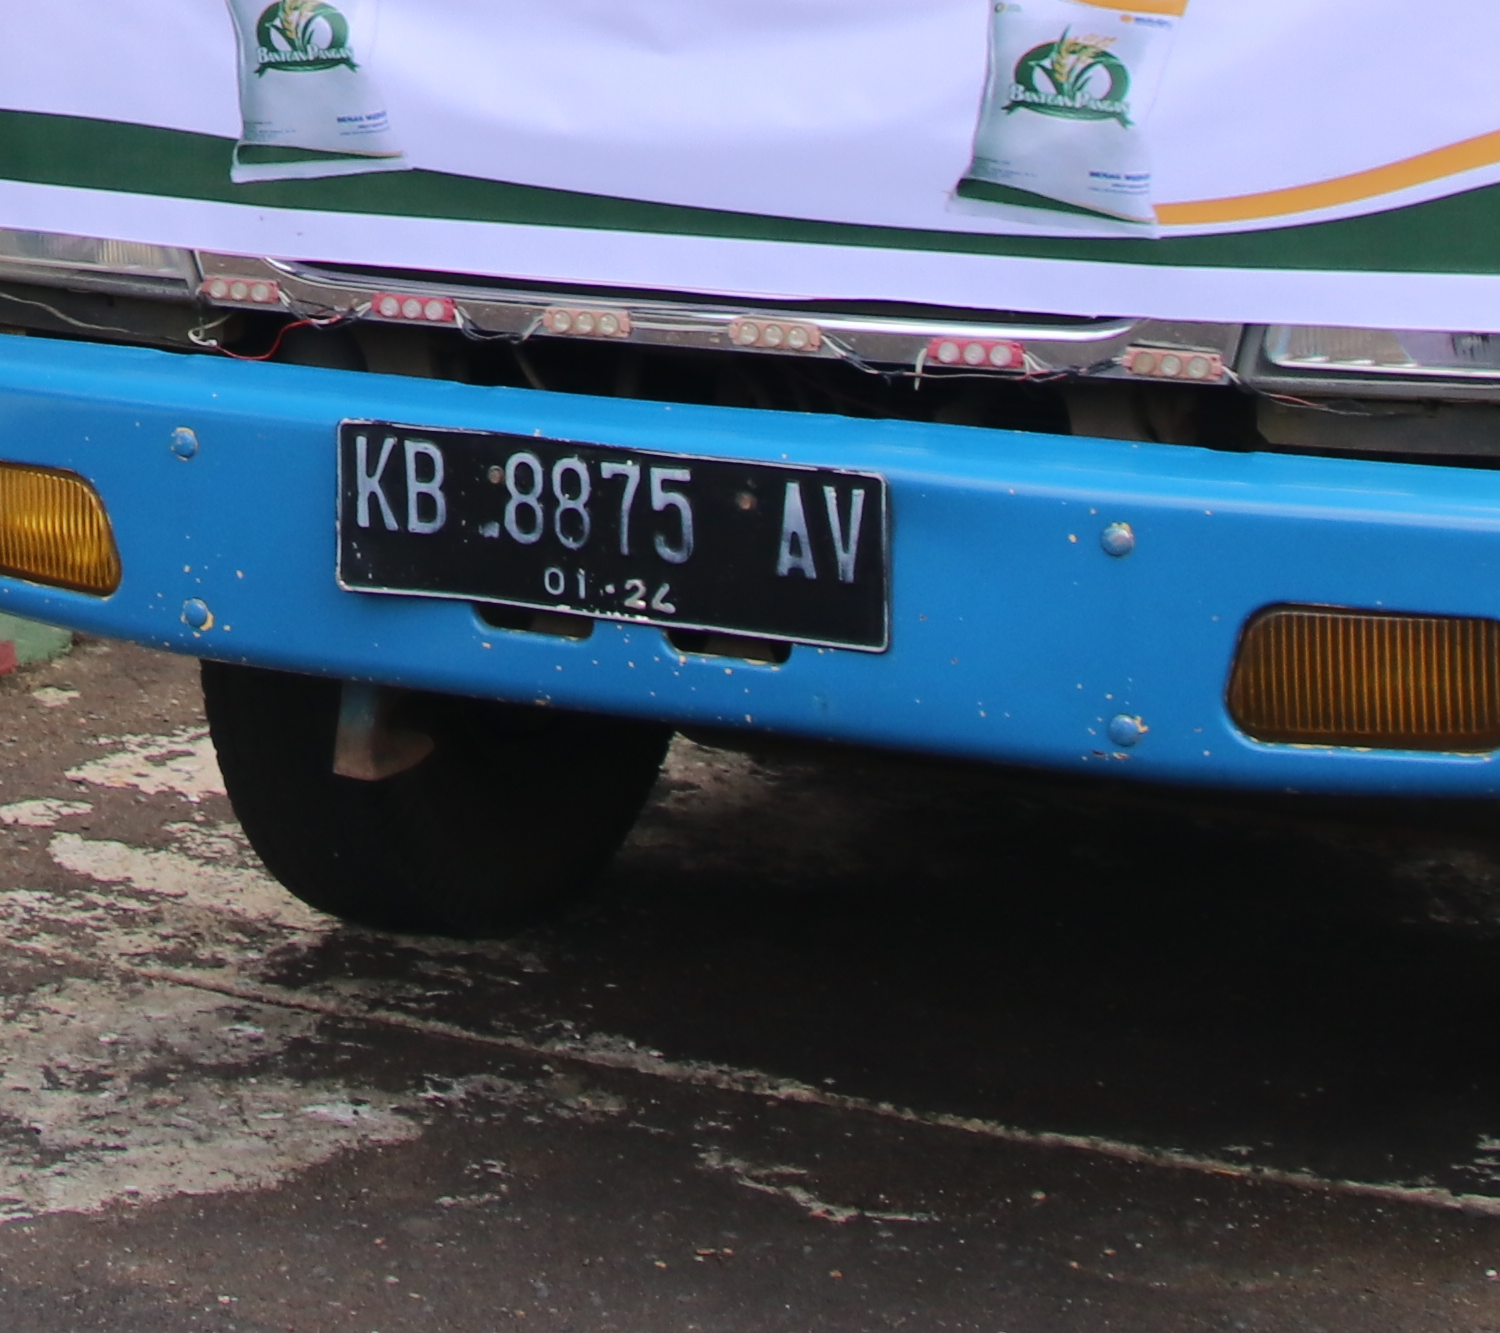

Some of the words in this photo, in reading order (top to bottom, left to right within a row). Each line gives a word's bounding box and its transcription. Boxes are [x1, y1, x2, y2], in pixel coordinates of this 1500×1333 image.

[355, 435, 447, 534] KB
[503, 450, 694, 565] 8875
[775, 481, 866, 583] AV
